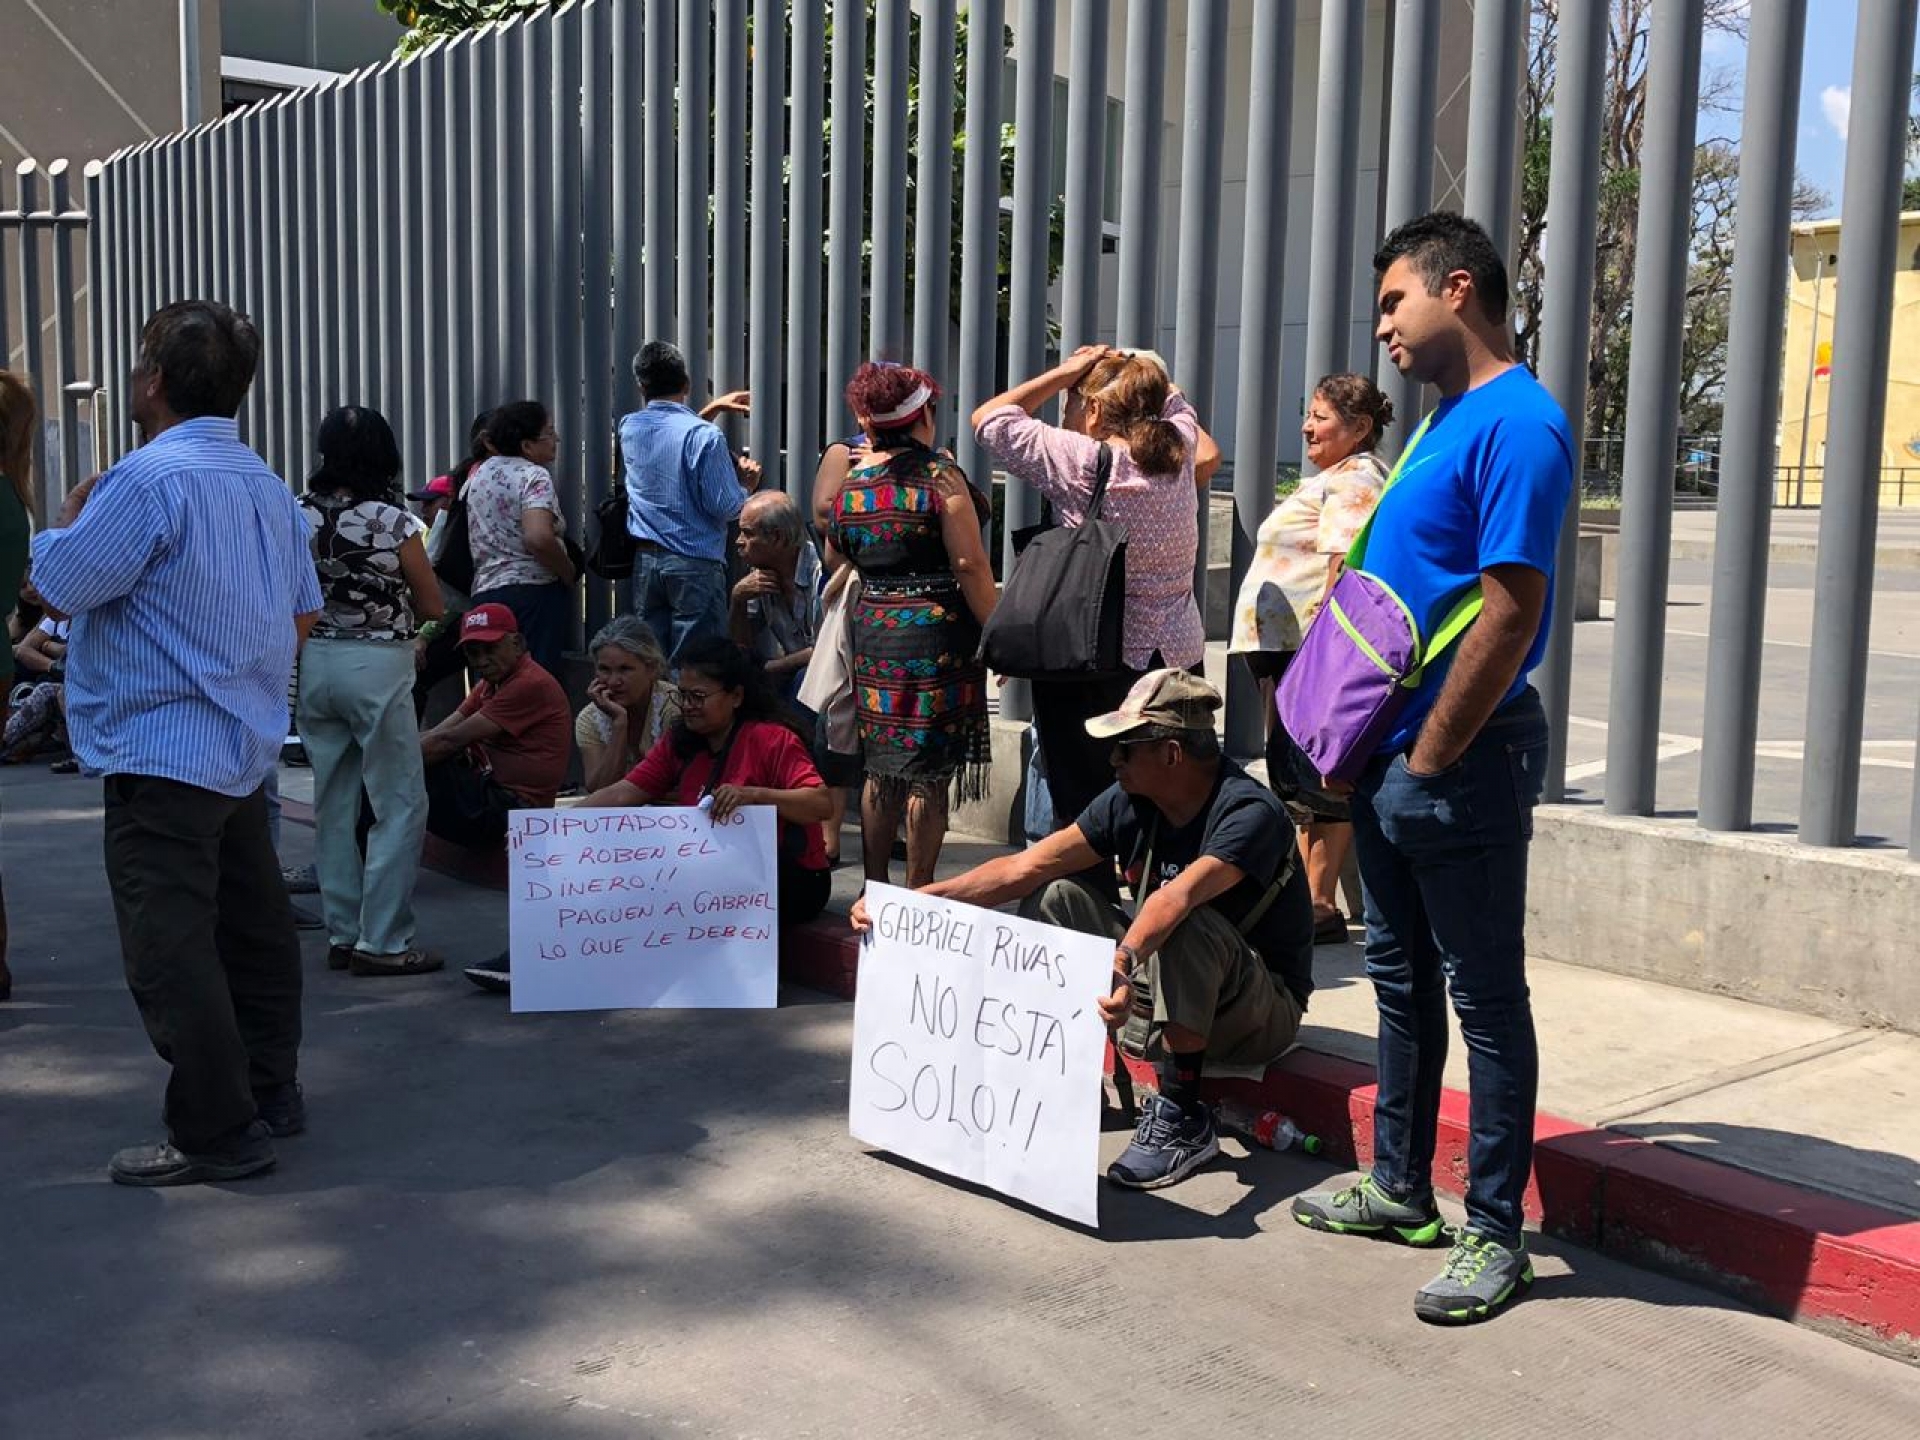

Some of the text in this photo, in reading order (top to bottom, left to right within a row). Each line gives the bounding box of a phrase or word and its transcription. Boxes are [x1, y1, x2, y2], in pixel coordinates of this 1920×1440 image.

[524, 839, 718, 868] SE ROBEN EL
[557, 890, 776, 928] PAGUEN A GABRIEL
[539, 923, 771, 960] LO QUE LE DEBEN
[910, 972, 1083, 1075] NO ESTÁ
